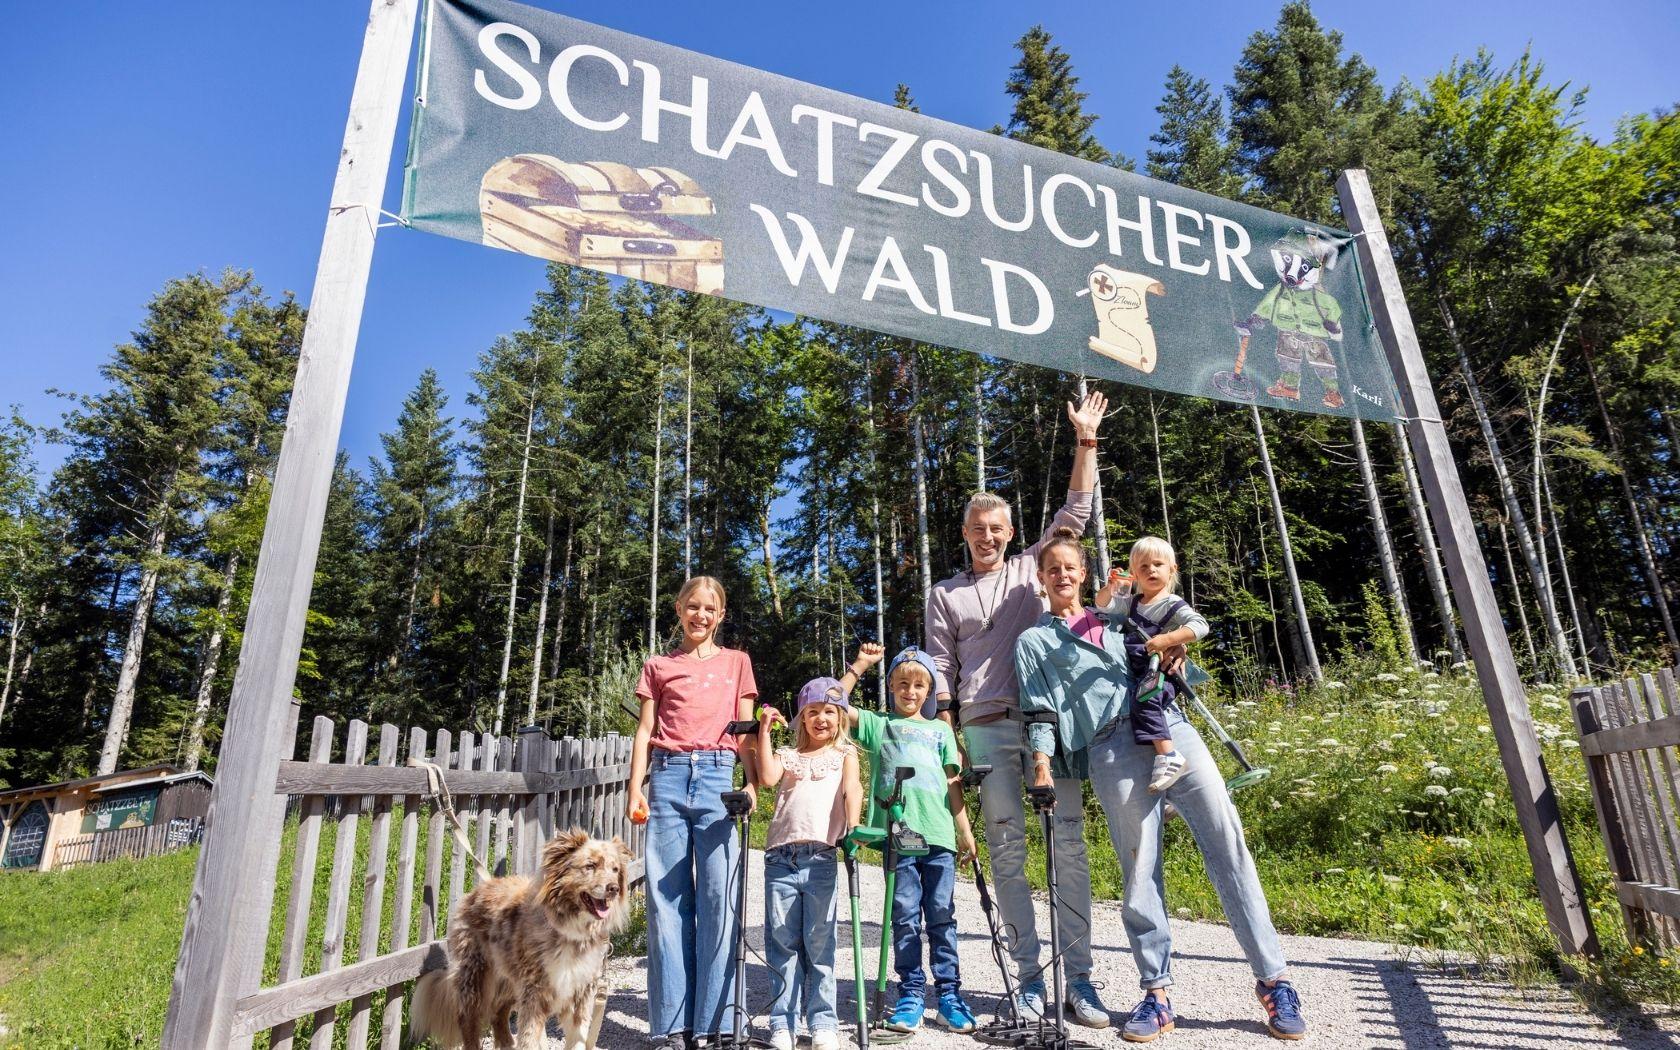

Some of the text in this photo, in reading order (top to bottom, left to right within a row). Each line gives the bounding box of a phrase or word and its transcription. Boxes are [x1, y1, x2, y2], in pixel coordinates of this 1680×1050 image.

[474, 22, 1264, 290] SCHATZSUCHER
[750, 203, 1055, 335] WALD
[1352, 384, 1383, 407] Karli
